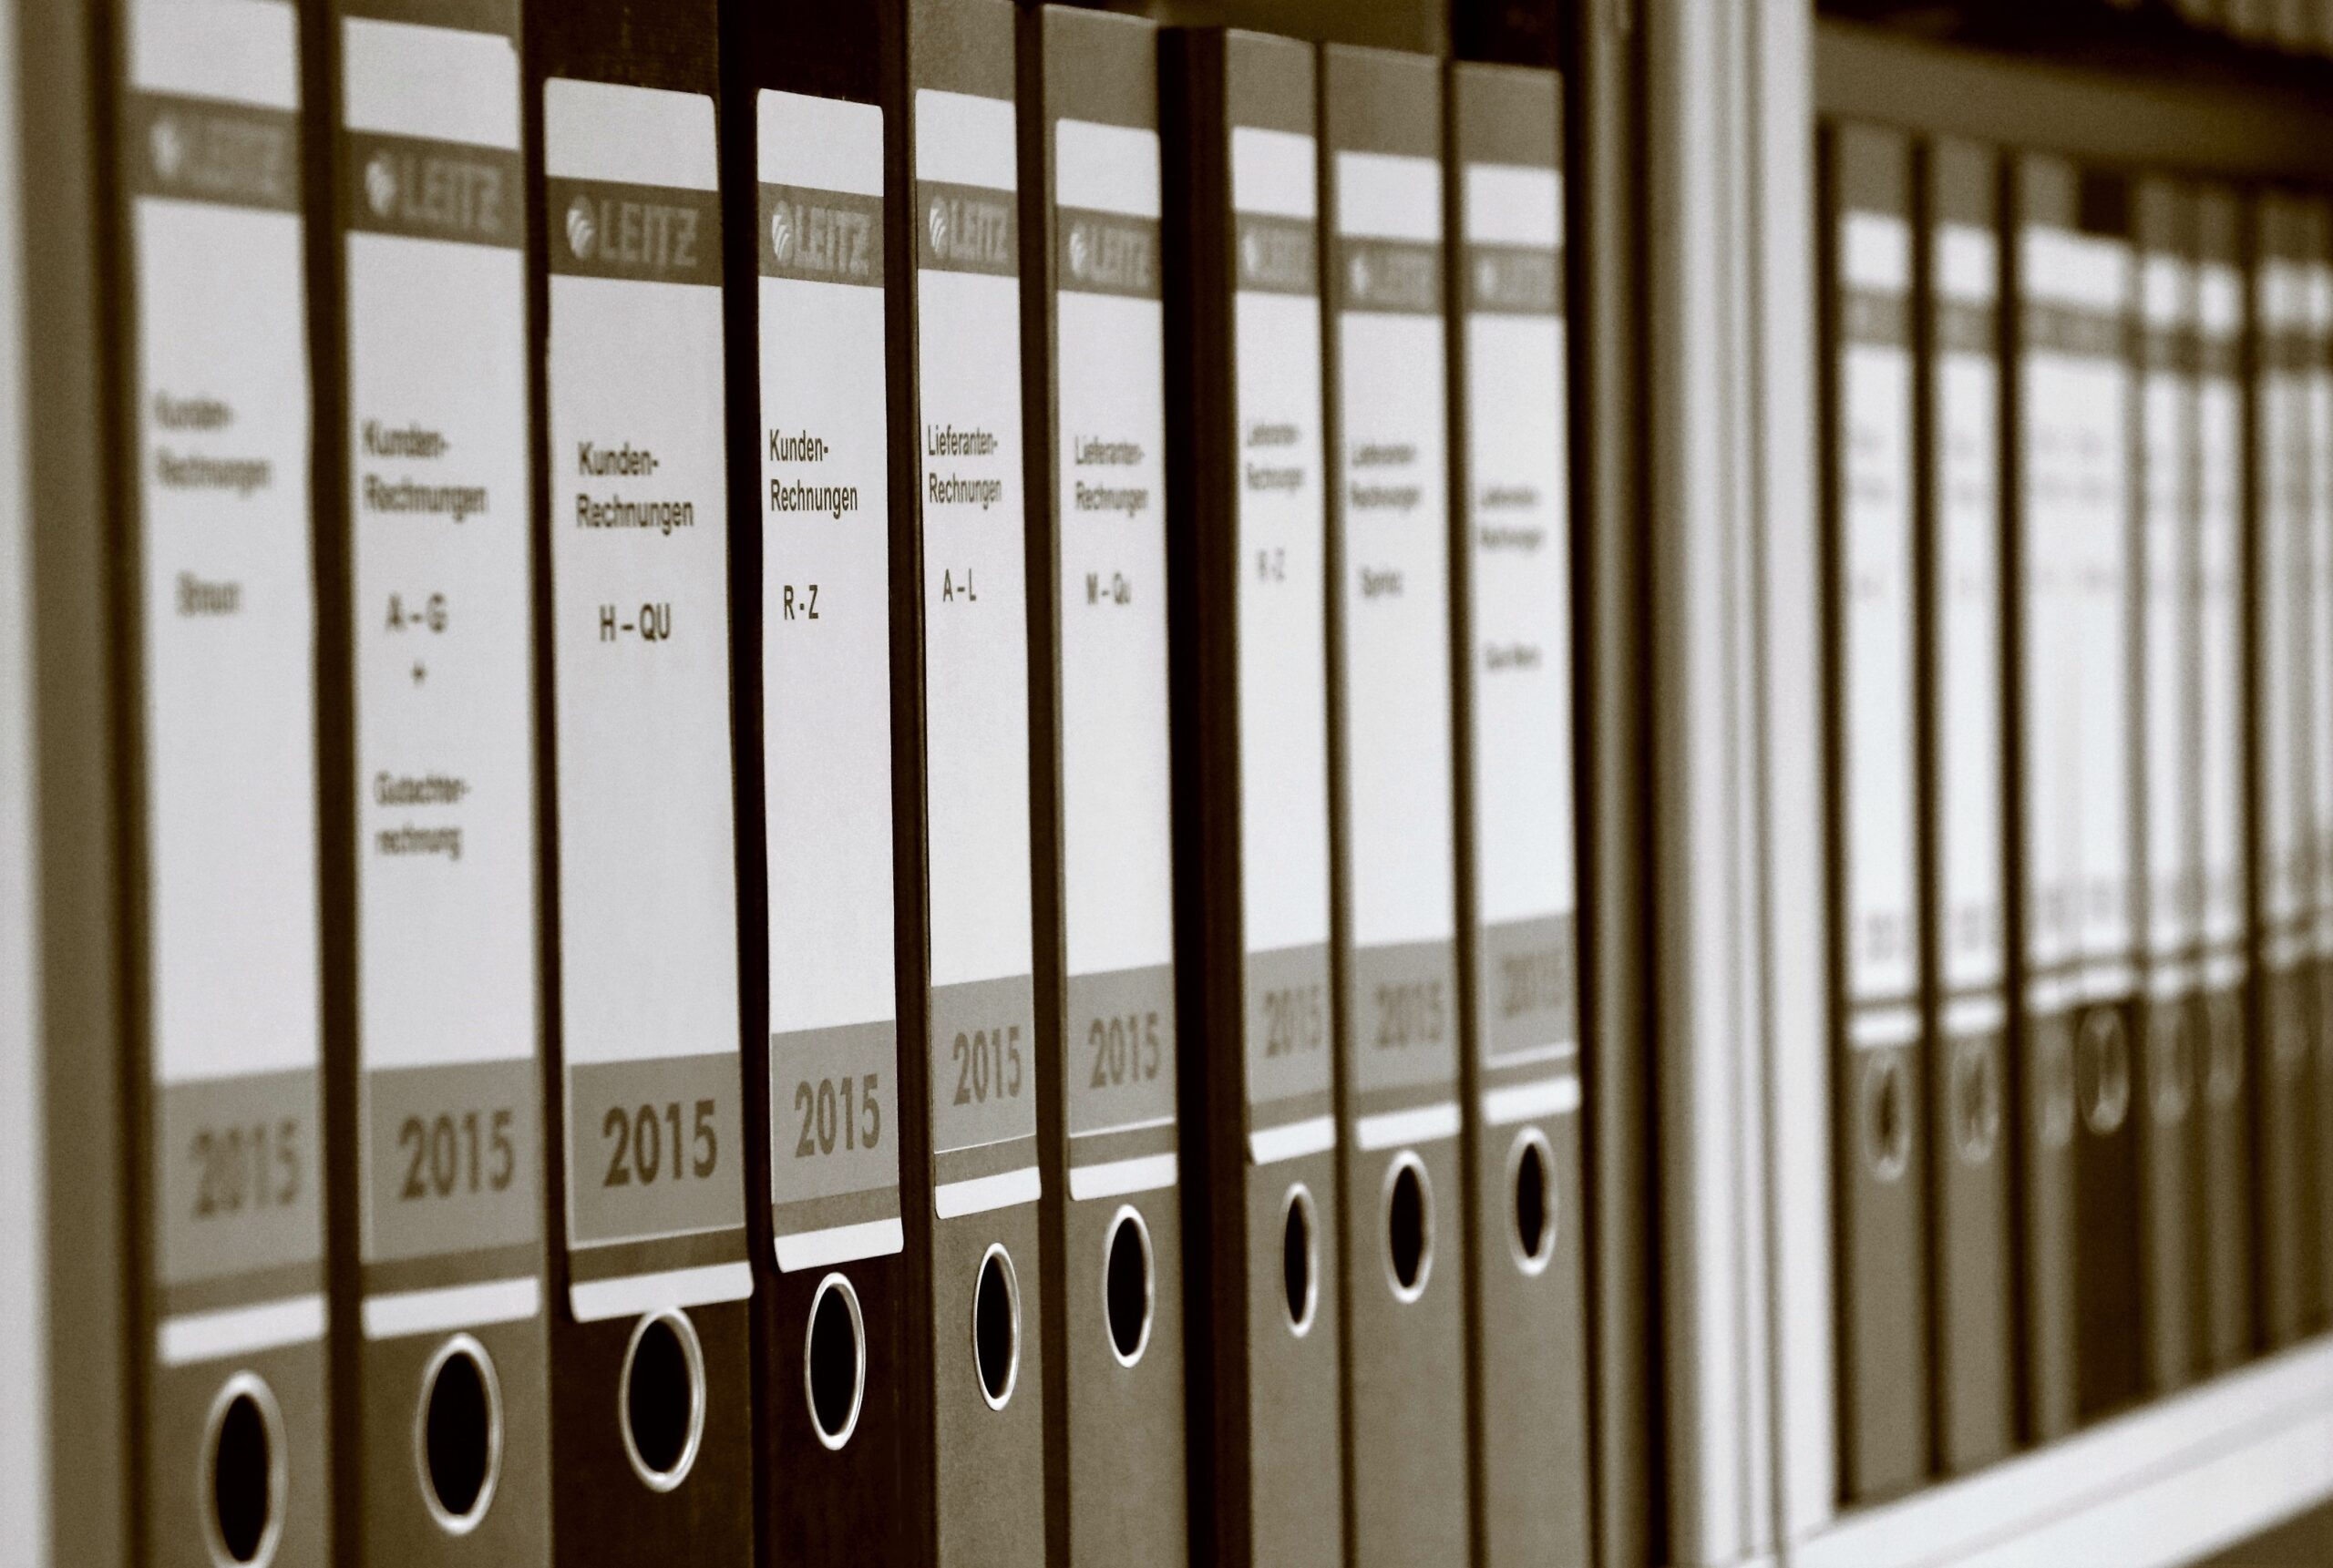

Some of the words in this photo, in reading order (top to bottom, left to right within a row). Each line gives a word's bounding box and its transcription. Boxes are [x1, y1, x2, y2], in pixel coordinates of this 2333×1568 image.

[401, 151, 508, 231] LEITZ
[599, 200, 699, 268] LEITZ
[795, 203, 871, 276] LEITZ
[950, 198, 1009, 261] LEITZ
[579, 442, 659, 477] Kunden-
[770, 429, 828, 462] Kunden-
[928, 425, 998, 456] Lieferanten-
[363, 474, 487, 523] Rechnungen
[577, 493, 694, 536] Rechnungen
[771, 478, 858, 519] Rechnungen
[929, 472, 1001, 510] Rechnungen
[1075, 480, 1148, 518] Rechnungen
[951, 1025, 1022, 1108] 2015
[1086, 1009, 1162, 1091] 2015
[601, 1099, 718, 1189] 2015
[794, 1072, 881, 1159] 2015
[188, 1116, 303, 1222] 2015
[396, 1108, 515, 1204] 2015
